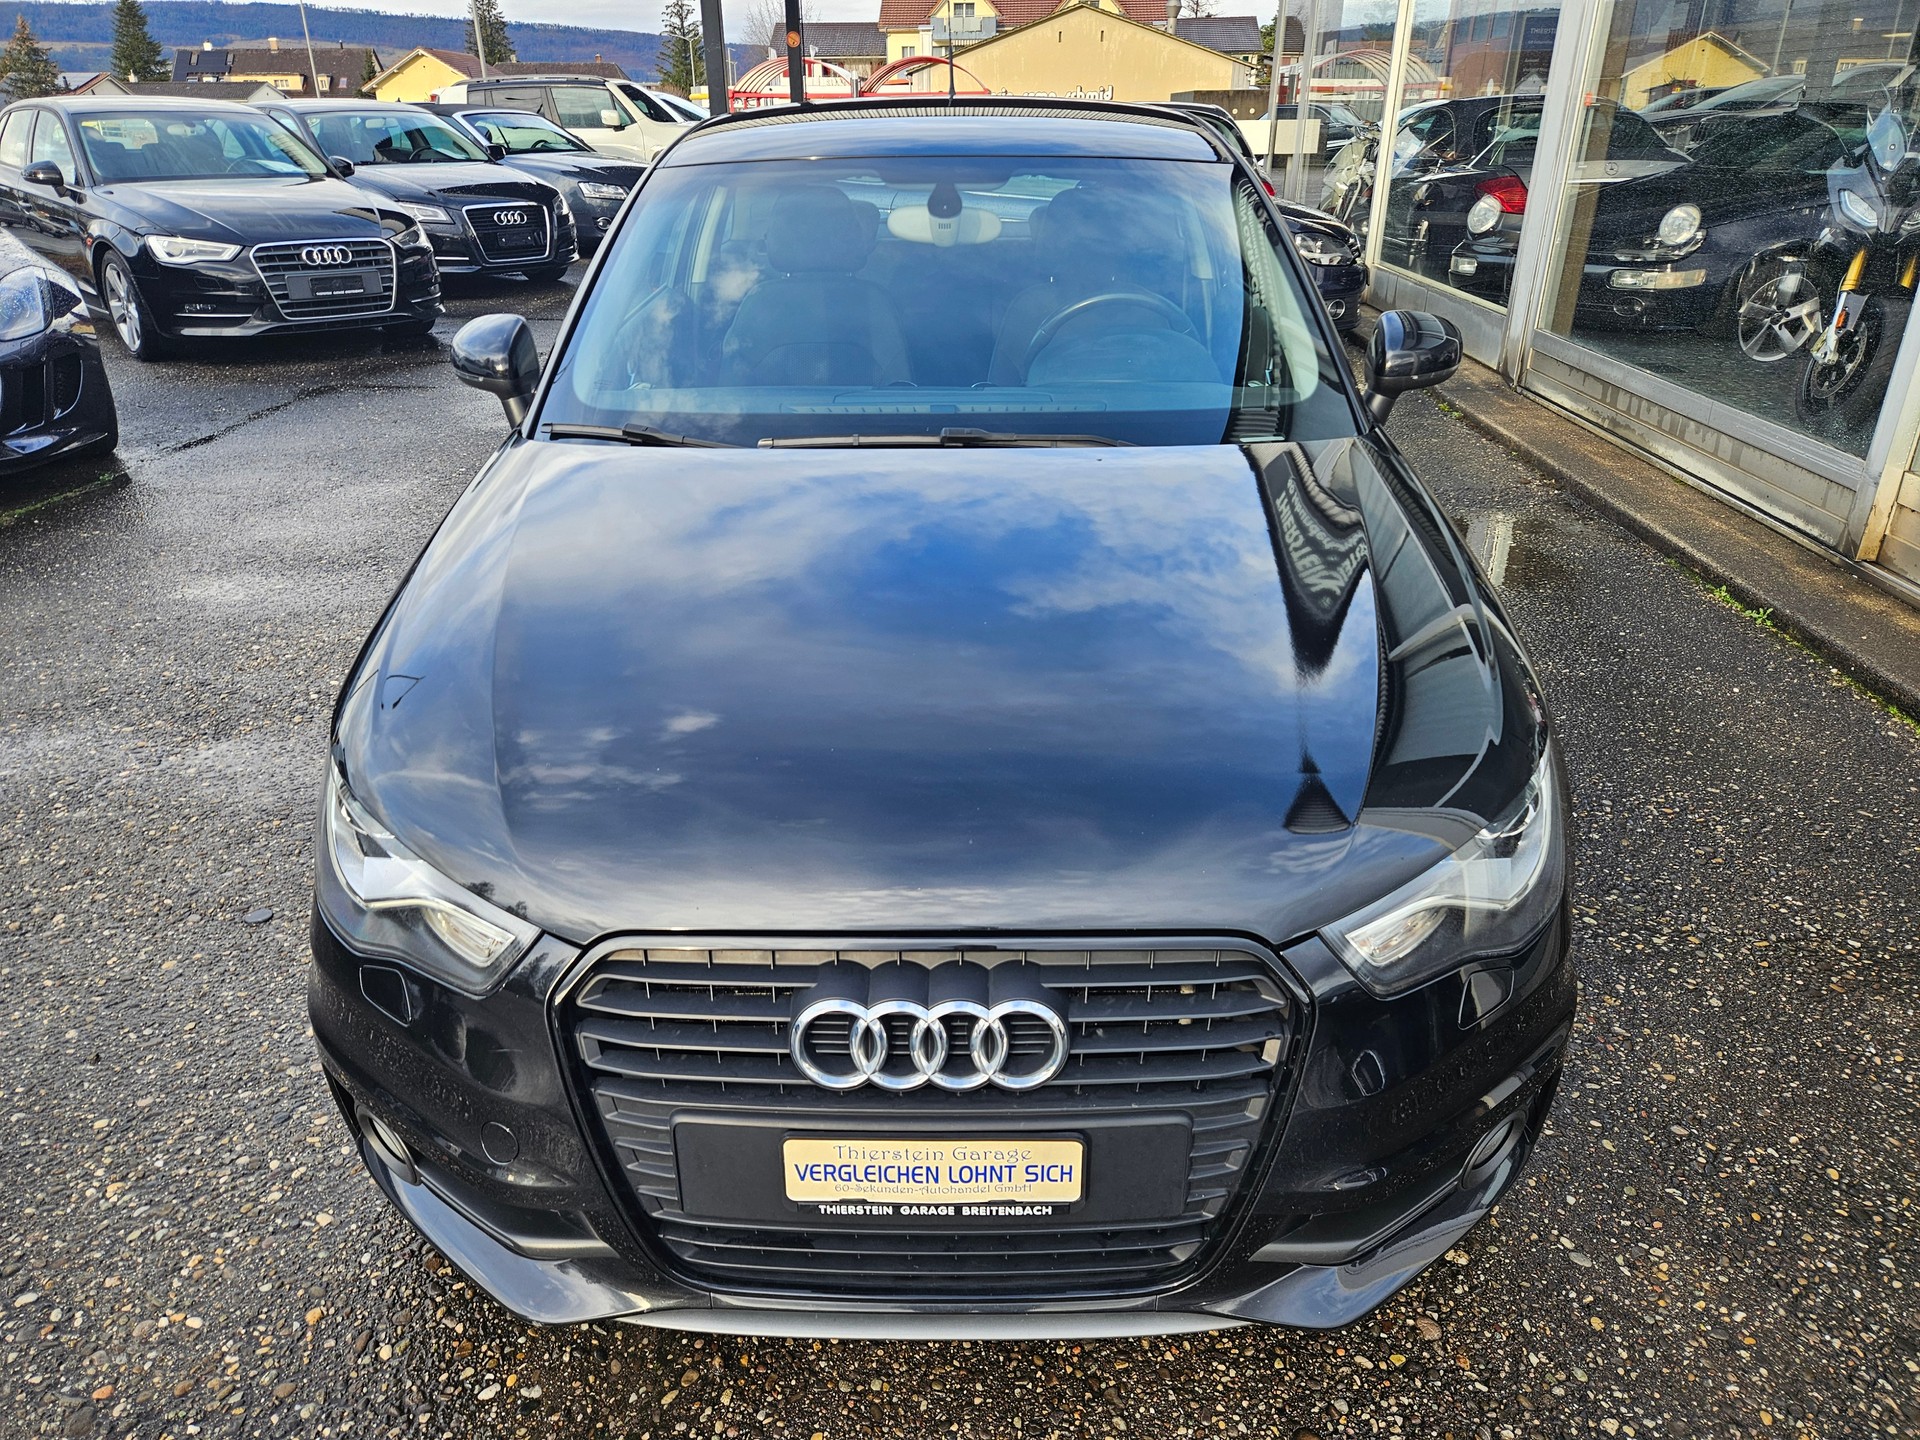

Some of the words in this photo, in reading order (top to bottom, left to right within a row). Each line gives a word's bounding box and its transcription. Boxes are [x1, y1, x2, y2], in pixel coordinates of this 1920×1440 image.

[1065, 85, 1114, 101] schmid
[833, 1144, 944, 1162] Thierstein
[952, 1146, 1032, 1163] Garage
[794, 1163, 939, 1184] VERGLEICHEN
[948, 1165, 1017, 1184] LOHNT
[1025, 1165, 1073, 1183] SICH
[994, 1183, 1032, 1193] GmbH
[819, 1205, 893, 1215] THIERSTEIN
[900, 1206, 955, 1215] GARAGE
[962, 1206, 1053, 1215] BREITENBACH
